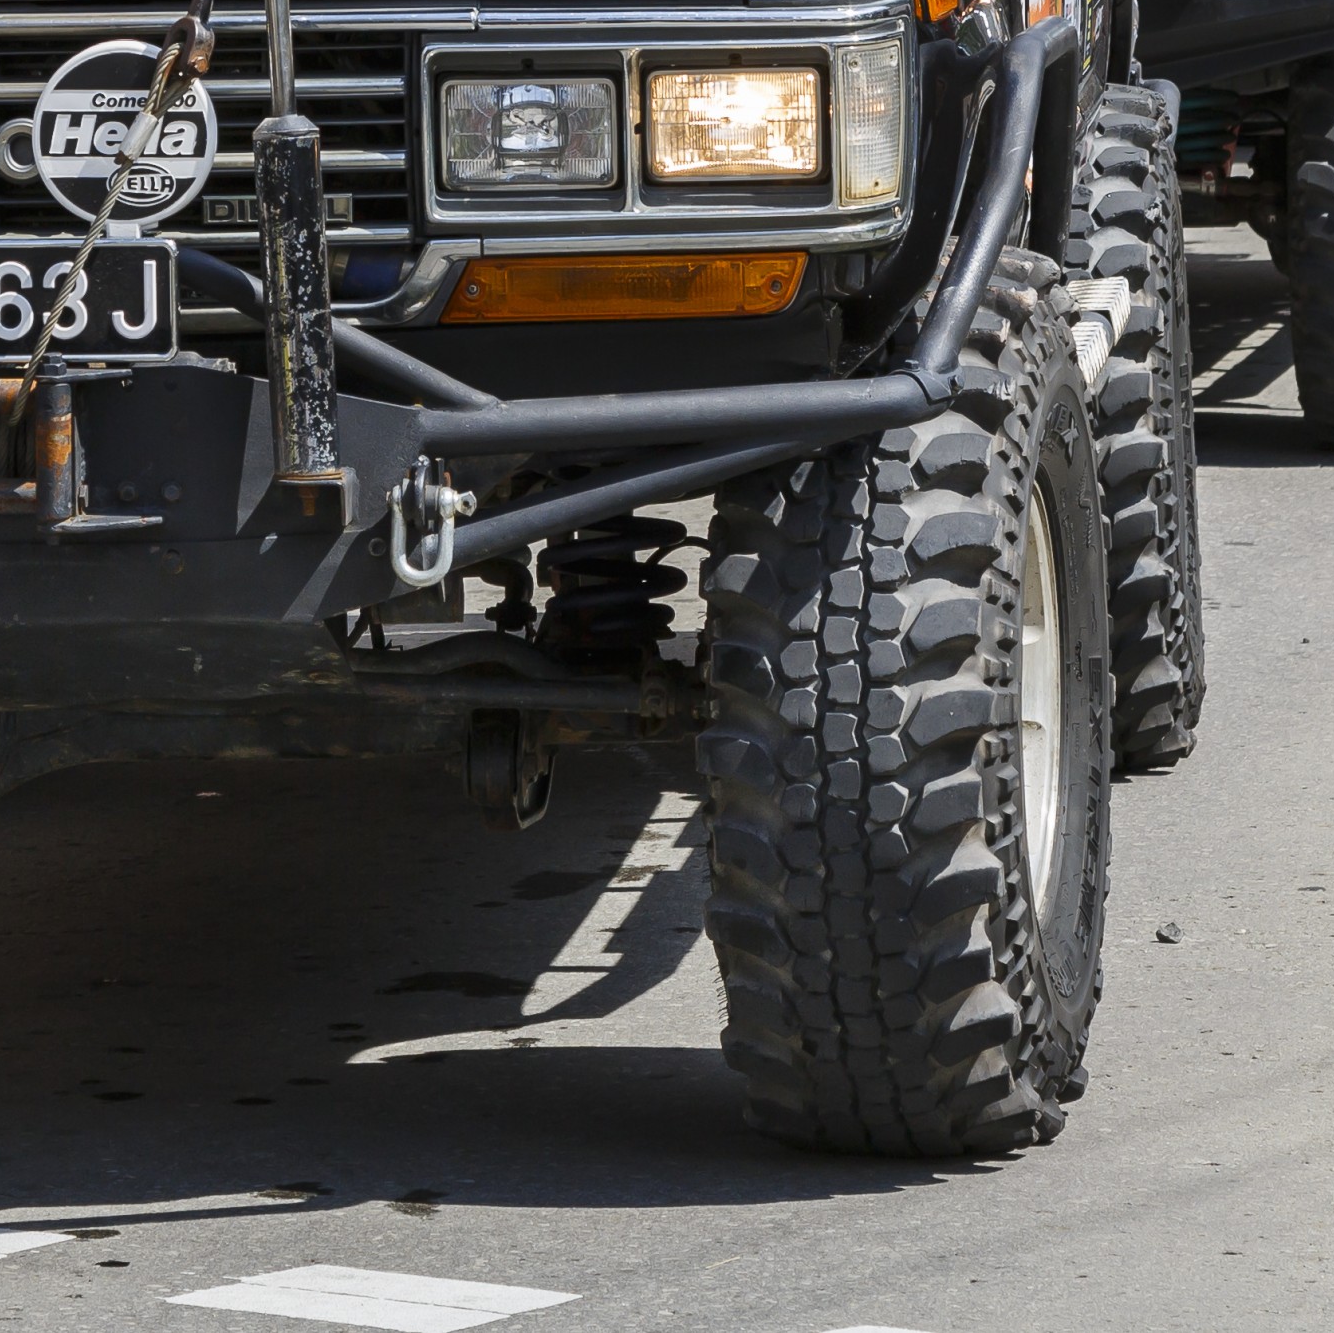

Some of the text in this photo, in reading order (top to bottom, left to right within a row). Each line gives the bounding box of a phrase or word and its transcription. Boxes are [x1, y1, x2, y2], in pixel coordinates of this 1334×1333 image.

[92, 93, 149, 108] Come
[49, 114, 198, 155] Hela
[123, 176, 174, 193] ELLA
[208, 199, 349, 222] DIL
[111, 259, 158, 340] J
